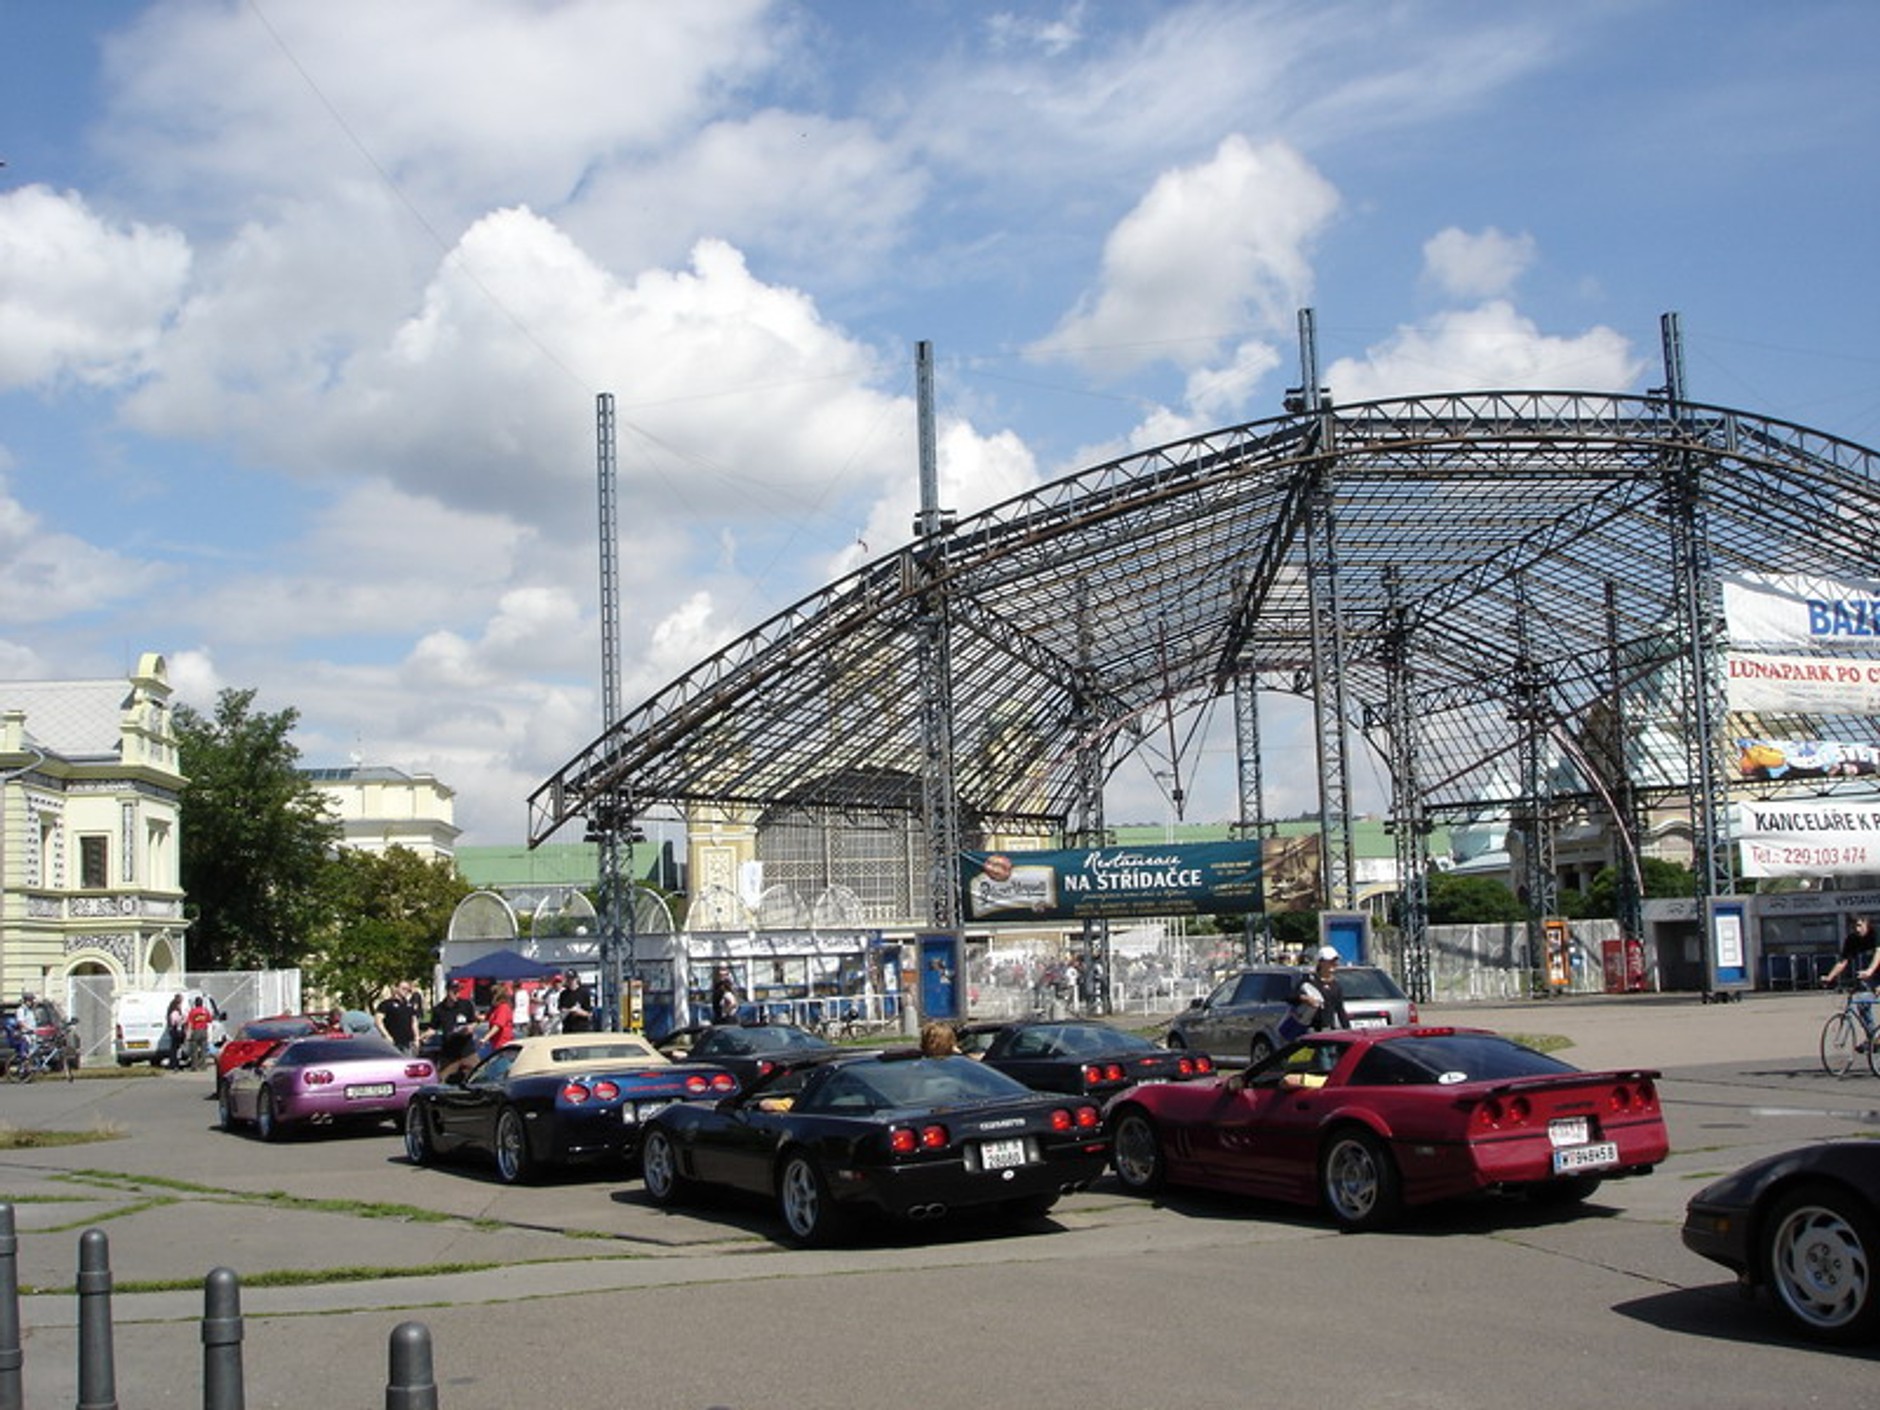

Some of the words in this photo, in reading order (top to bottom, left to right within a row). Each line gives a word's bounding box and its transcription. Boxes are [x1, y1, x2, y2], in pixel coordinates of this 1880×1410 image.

[1729, 660, 1834, 681] LUNAPARK
[1836, 666, 1860, 682] PO
[1857, 813, 1872, 830] K
[1814, 848, 1839, 866] 103
[1842, 847, 1866, 864] 474
[1064, 874, 1091, 891] NA
